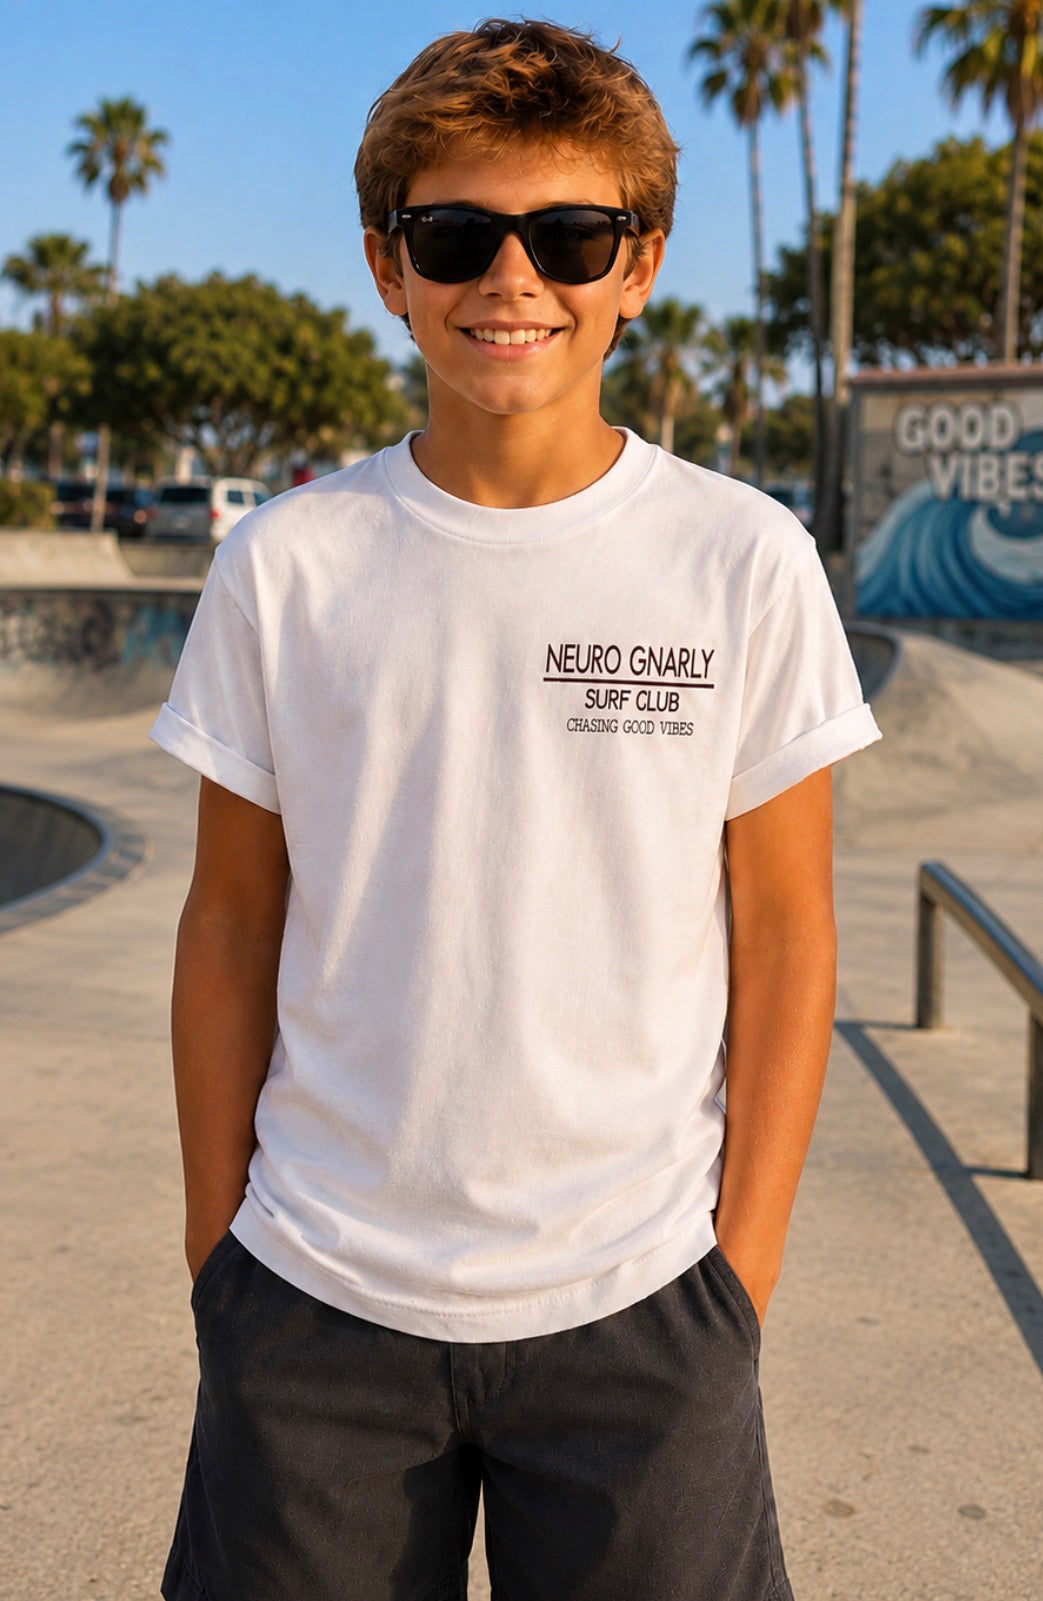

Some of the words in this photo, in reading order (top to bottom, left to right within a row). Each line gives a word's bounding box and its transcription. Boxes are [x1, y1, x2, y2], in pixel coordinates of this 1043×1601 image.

[895, 404, 1019, 452] GOOD
[545, 643, 621, 675] NEURO
[629, 645, 715, 679] GNARLY
[584, 688, 631, 711] SURF
[635, 690, 680, 712] CLUB
[566, 717, 619, 734] CHASING
[622, 719, 655, 735] GOOD
[660, 721, 694, 736] VIBES
